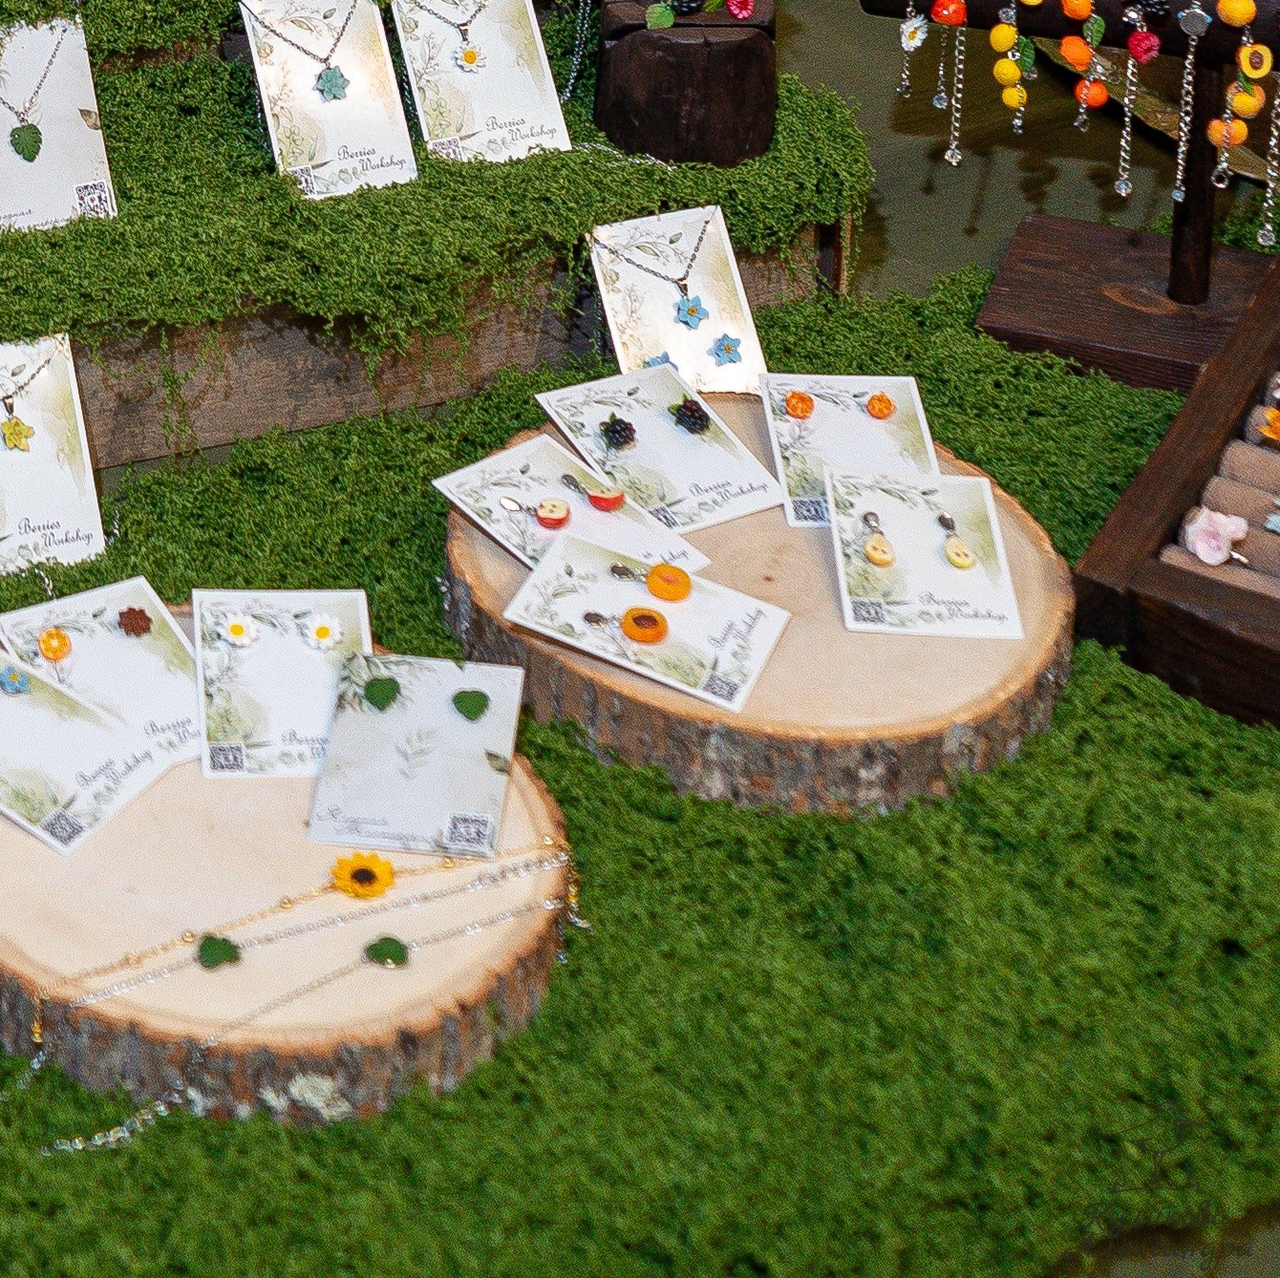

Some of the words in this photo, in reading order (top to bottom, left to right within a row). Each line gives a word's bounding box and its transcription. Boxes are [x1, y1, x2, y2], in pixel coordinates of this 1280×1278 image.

[484, 115, 526, 132] Berries
[508, 124, 557, 142] Workshop
[337, 144, 377, 161] Berries
[358, 154, 406, 172] Workshop
[18, 517, 61, 536] Berries
[40, 528, 94, 547] Workshop
